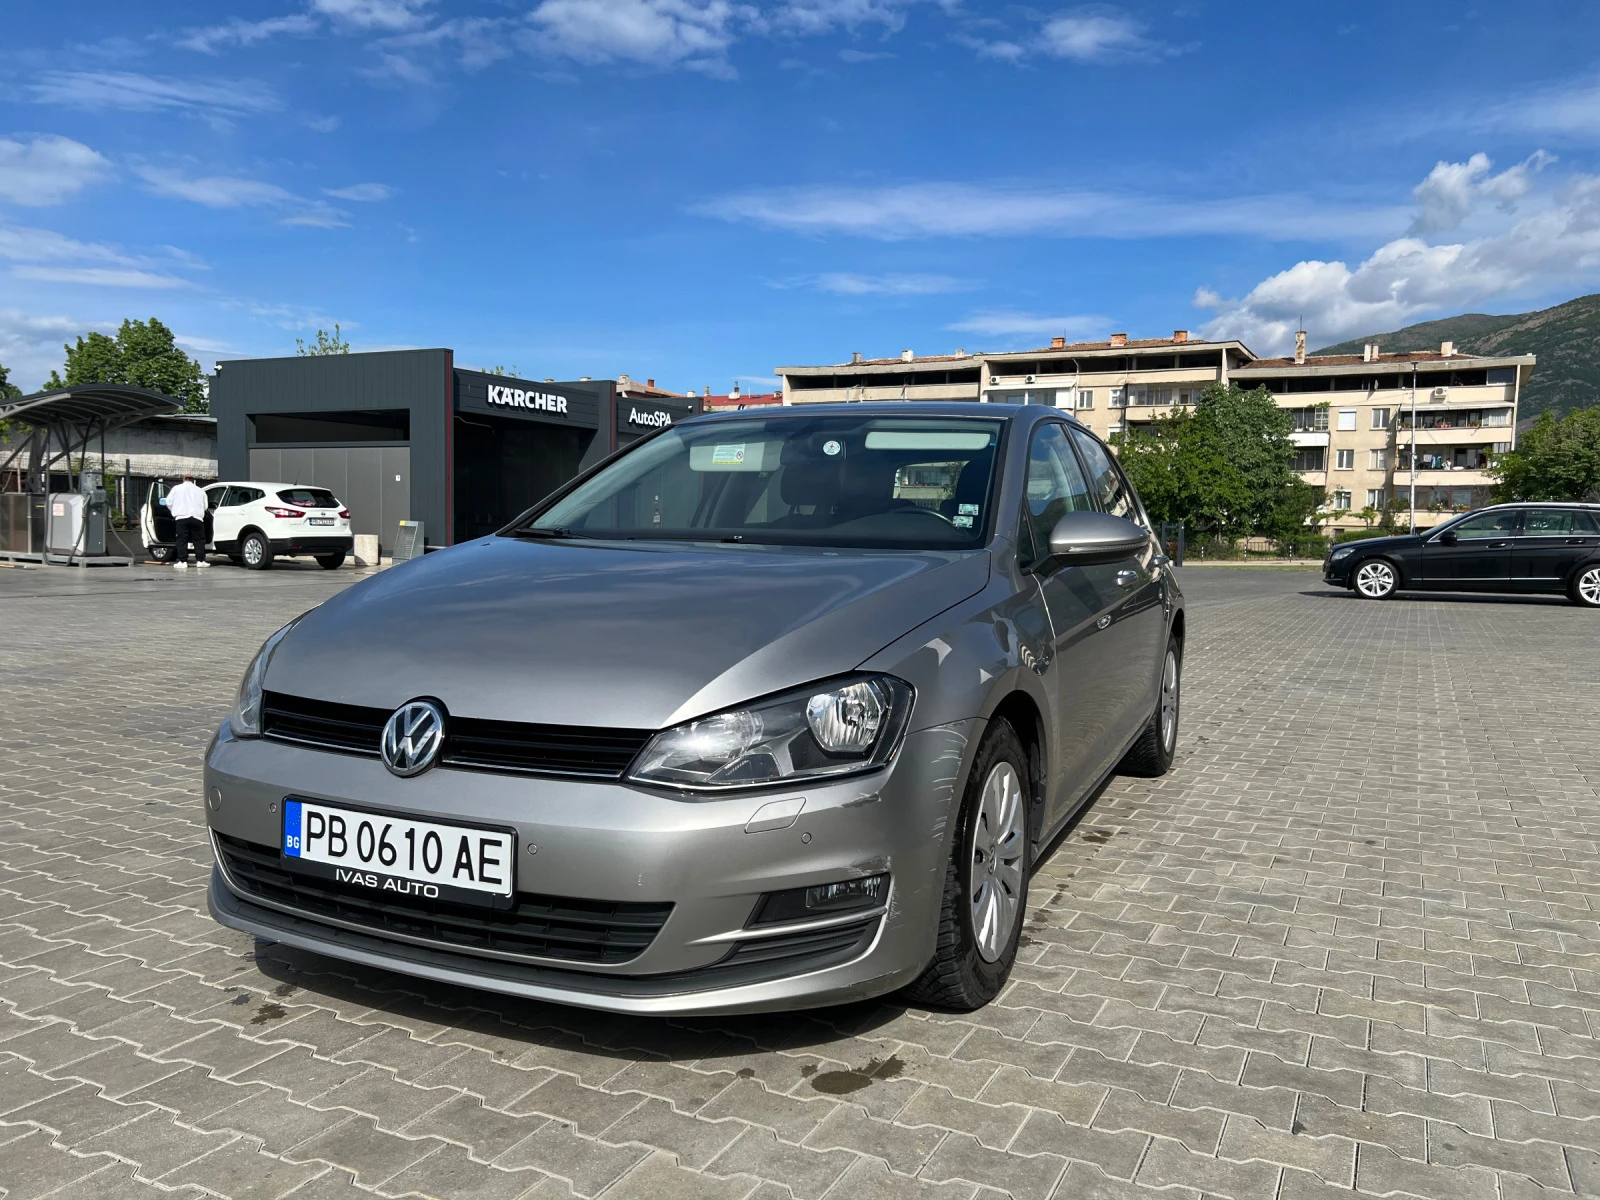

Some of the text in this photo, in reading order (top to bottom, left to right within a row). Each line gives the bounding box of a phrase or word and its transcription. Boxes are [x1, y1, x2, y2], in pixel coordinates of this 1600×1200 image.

[488, 384, 568, 414] KÄRCHER
[629, 407, 672, 427] AutoSPA
[287, 835, 300, 849] BG
[306, 811, 503, 885] PB 0610 AE
[335, 868, 439, 899] IVAS AUTO
